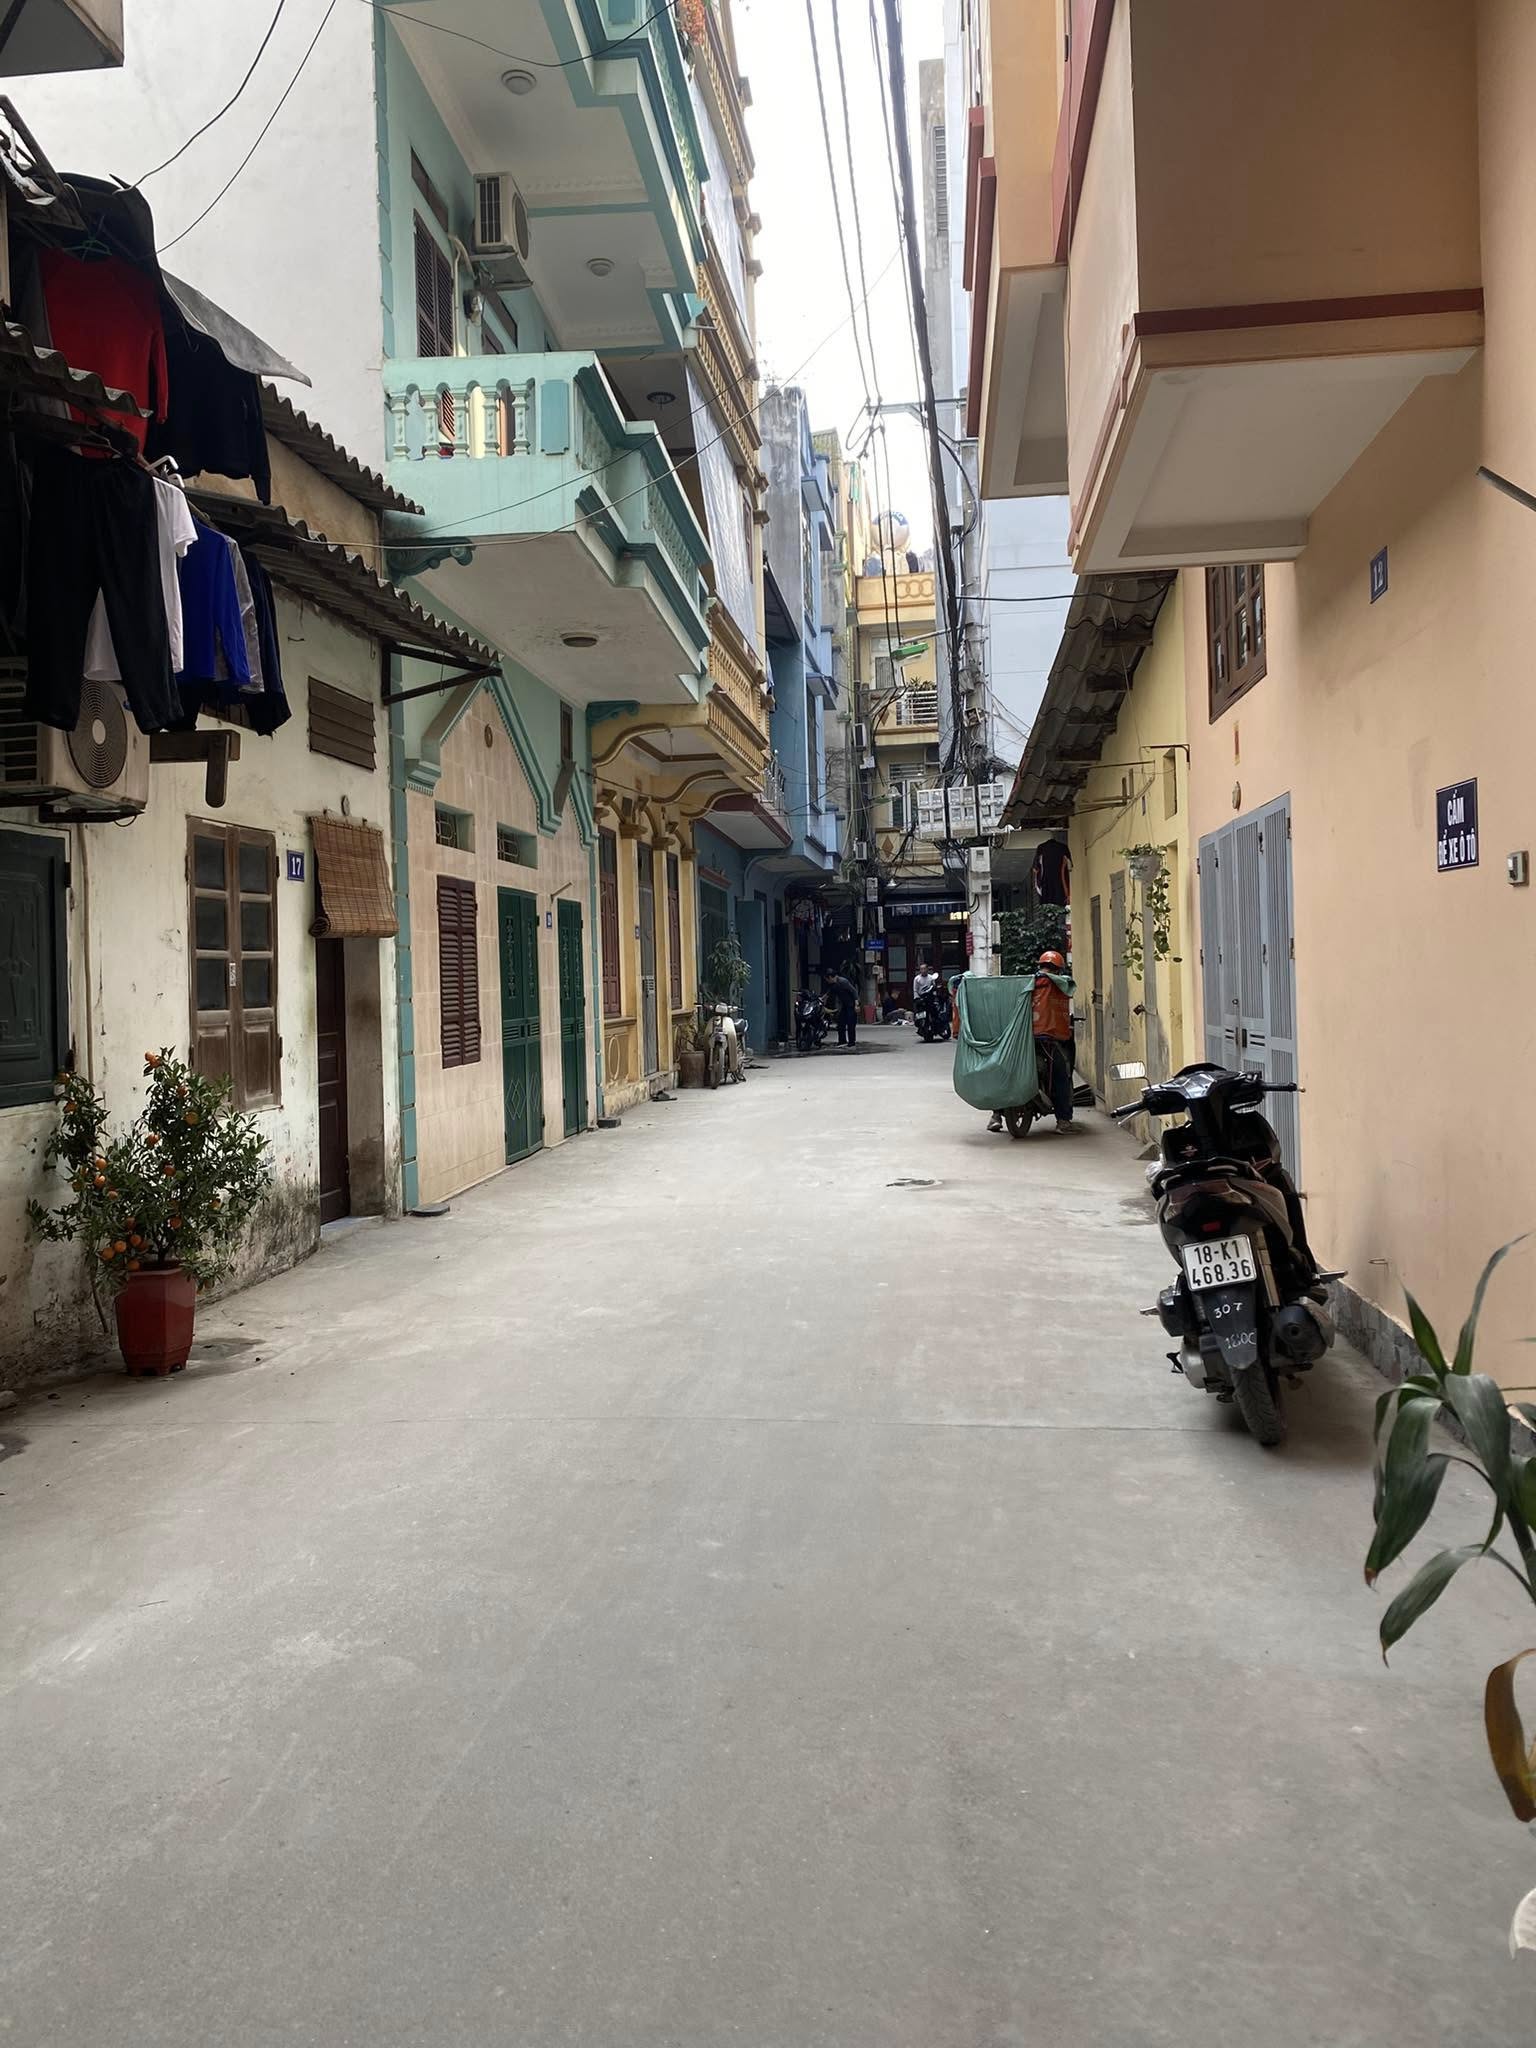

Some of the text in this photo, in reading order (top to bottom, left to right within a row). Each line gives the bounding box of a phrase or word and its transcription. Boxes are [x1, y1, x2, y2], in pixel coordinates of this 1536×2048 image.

[1449, 837, 1459, 864] XE
[1459, 830, 1465, 862] Ô
[1466, 828, 1476, 861] TÔ
[291, 856, 302, 876] 17
[1194, 1240, 1240, 1265] 18-K1
[1192, 1259, 1252, 1286] 468.36
